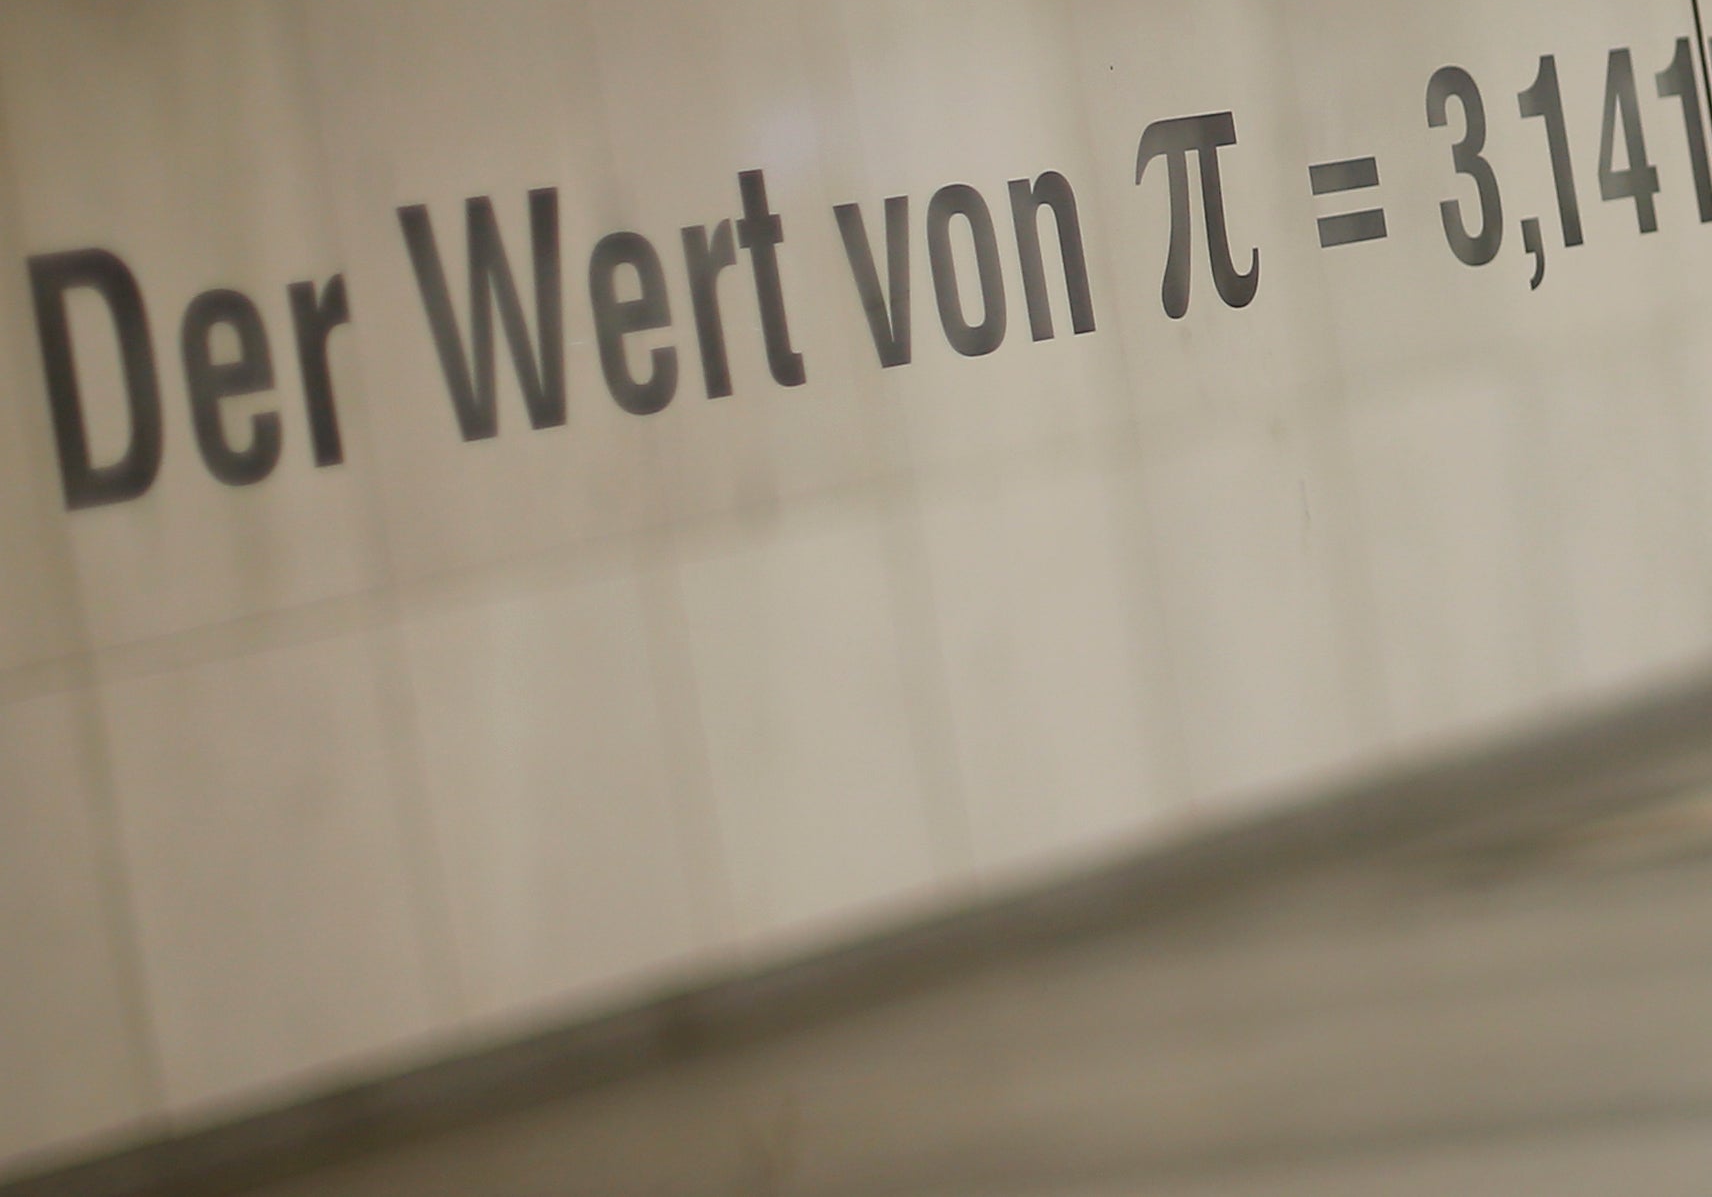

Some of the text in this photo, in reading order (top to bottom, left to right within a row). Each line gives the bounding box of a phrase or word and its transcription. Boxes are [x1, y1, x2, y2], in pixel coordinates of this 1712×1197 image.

[26, 246, 350, 510] Der
[396, 168, 807, 442] Wert
[833, 170, 1096, 368] von
[1135, 111, 1260, 319] π
[1308, 156, 1387, 248] =
